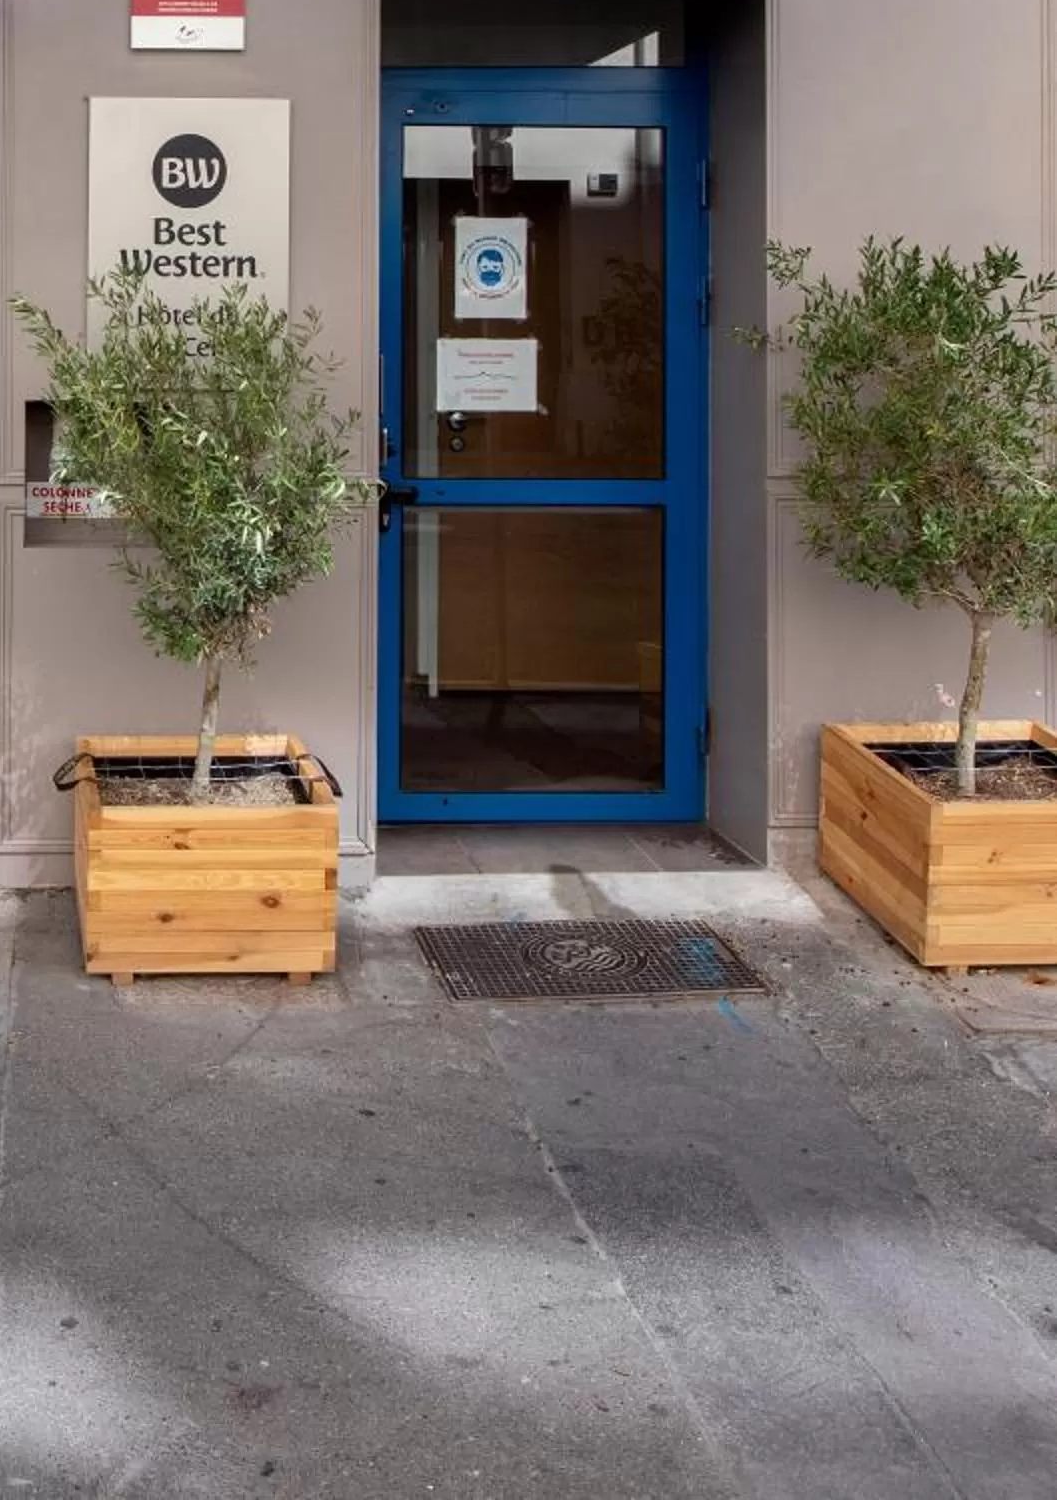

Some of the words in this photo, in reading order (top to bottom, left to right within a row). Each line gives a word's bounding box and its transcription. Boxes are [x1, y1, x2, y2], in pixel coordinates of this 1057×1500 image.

[161, 156, 221, 190] BW
[152, 216, 228, 247] Best
[119, 249, 259, 278] Western
